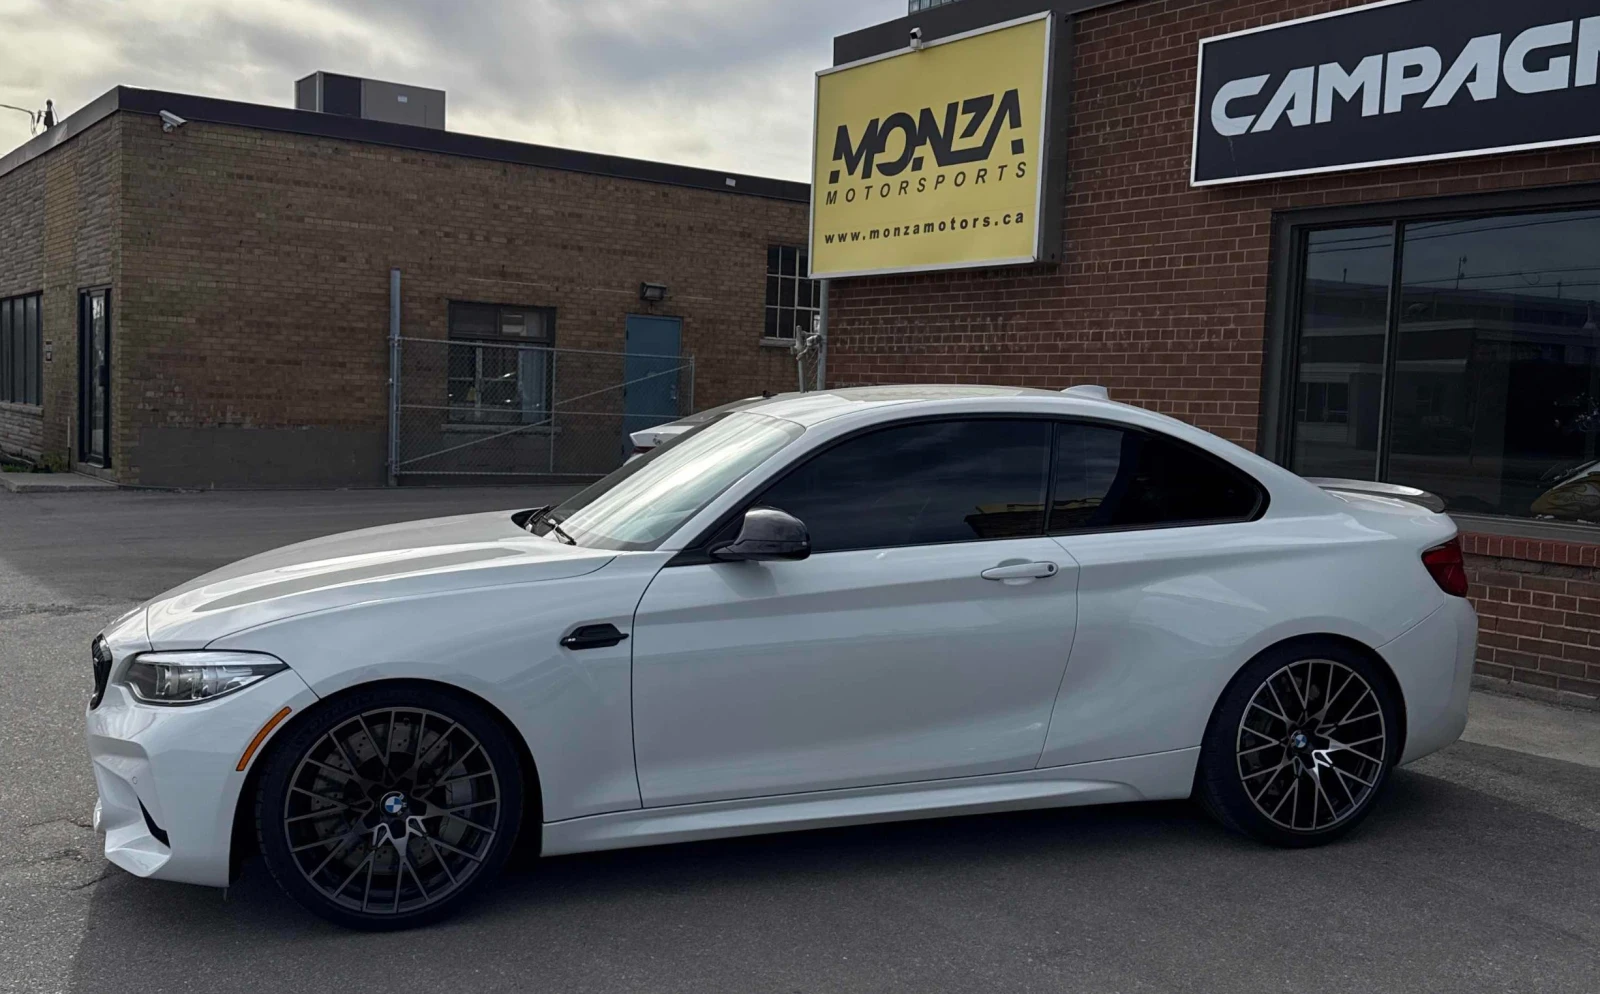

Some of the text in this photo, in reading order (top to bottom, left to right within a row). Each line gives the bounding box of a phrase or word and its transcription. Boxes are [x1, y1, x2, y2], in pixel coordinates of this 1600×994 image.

[828, 88, 1025, 185] MONZA
[825, 161, 1027, 206] MOTORSPORTS
[824, 211, 1024, 244] www.monzamotors.ca
